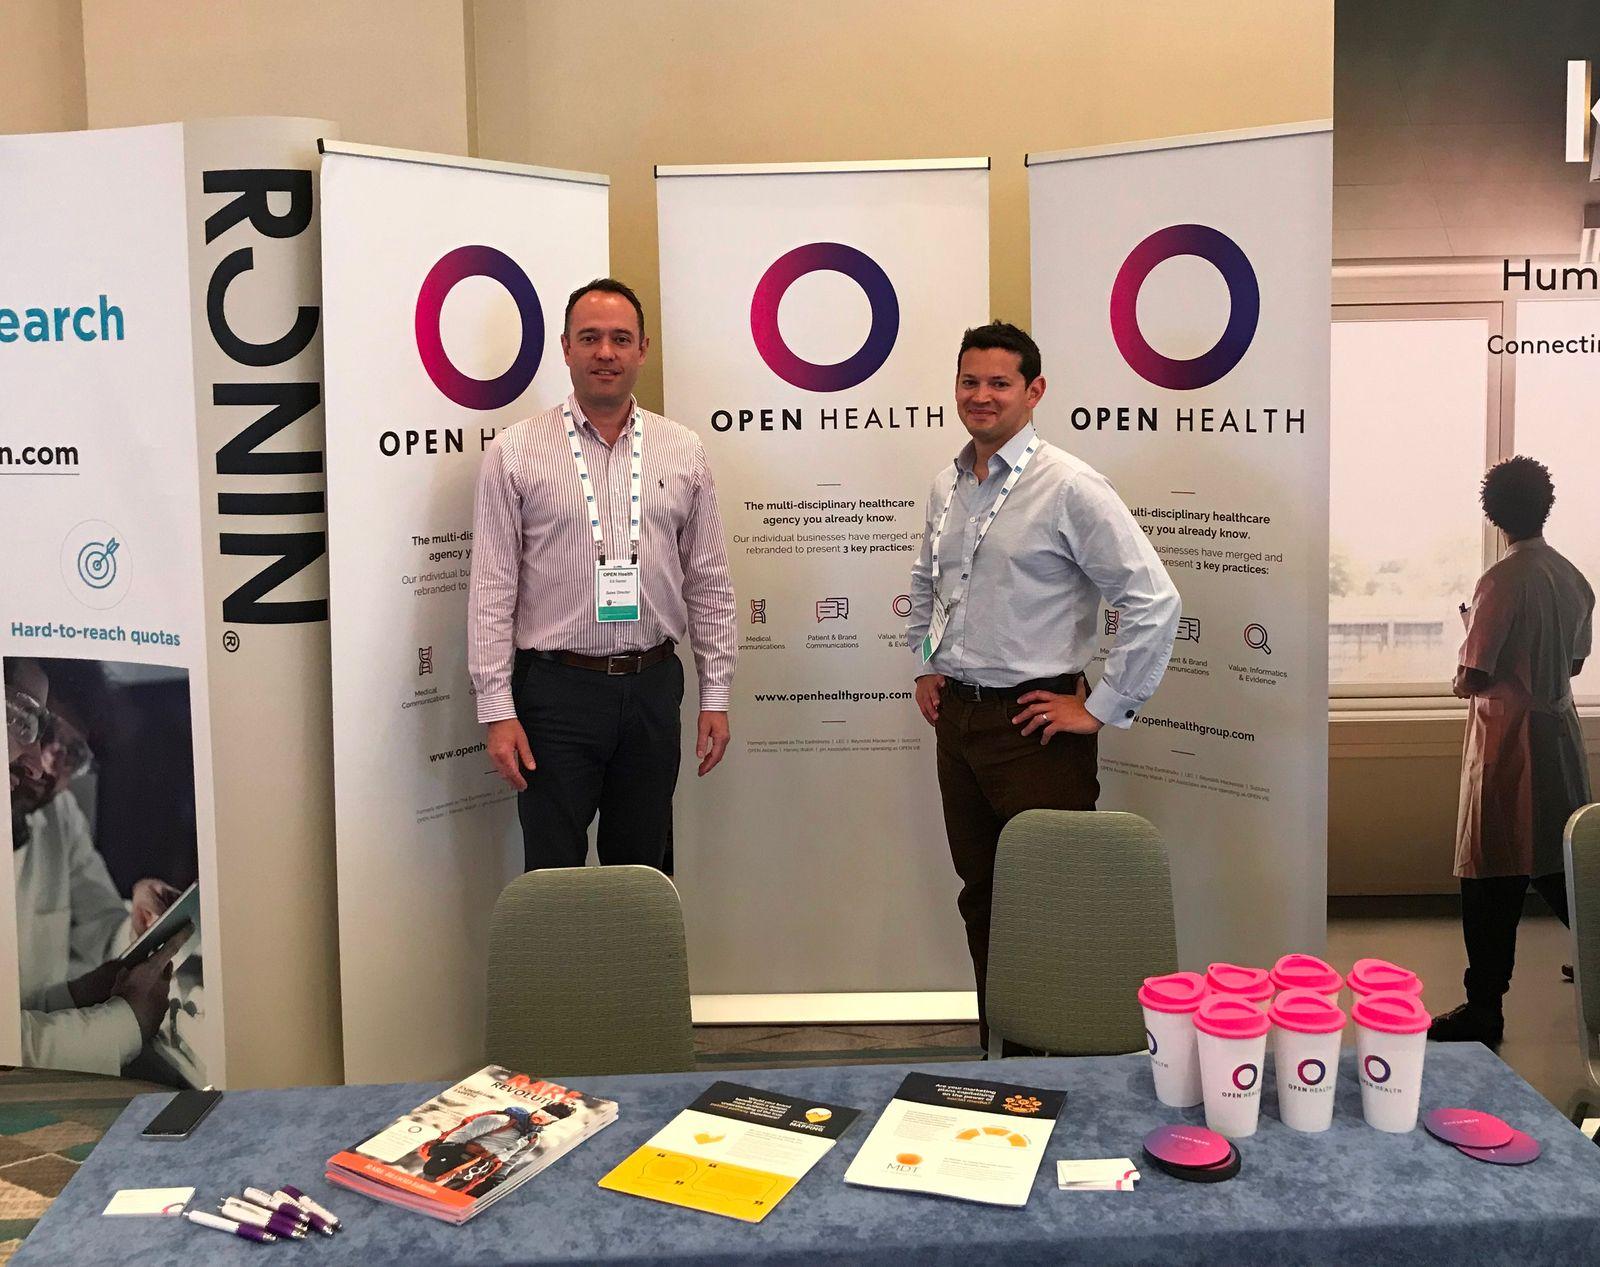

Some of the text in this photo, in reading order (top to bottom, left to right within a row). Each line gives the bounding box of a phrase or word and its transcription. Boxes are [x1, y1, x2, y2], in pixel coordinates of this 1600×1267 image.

[1503, 259, 1598, 291] Hum
[0, 294, 125, 343] earch
[1487, 333, 1600, 354] Connecti
[711, 405, 944, 432] OPEN HEALTH
[1071, 406, 1305, 434] OPEN HEALTH
[379, 428, 464, 456] OPEN
[744, 499, 915, 512] The multi-disciplinary healthcare
[762, 513, 897, 526] agency you already know.
[1130, 507, 1271, 525] ulti-disciplinary healthcare
[733, 534, 749, 543] Our
[752, 533, 795, 543] individual
[796, 532, 846, 543] businesses
[848, 532, 871, 542] have
[872, 531, 908, 543] merged
[1156, 525, 1176, 536] you
[1178, 525, 1217, 539] already
[1219, 528, 1251, 540] know.
[412, 535, 430, 546] The
[428, 548, 464, 562] agency
[746, 542, 915, 555] rebranded to present 3 key practices:
[1201, 547, 1223, 559] have
[1225, 550, 1262, 563] merged
[1264, 553, 1283, 563] and
[1196, 561, 1201, 570] 3
[1203, 560, 1220, 573] key
[1222, 562, 1270, 576] practices:
[401, 575, 417, 585] Our
[420, 569, 458, 582] individual
[414, 582, 468, 597] rebranded to
[11, 621, 181, 647] Hard-to-reach quotas
[745, 634, 772, 642] Medical
[807, 633, 830, 641] Patient
[837, 633, 858, 641] Brand
[805, 641, 860, 650] Communications
[1188, 658, 1208, 667] Brand
[1249, 666, 1288, 678] Informatics
[1245, 675, 1277, 686] Evidence
[414, 687, 438, 697] Medical
[754, 689, 912, 703] www.openhealthgroup.com
[401, 694, 450, 710] Communications
[1288, 1083, 1307, 1093] OPEN
[1375, 1084, 1402, 1093] HEALTH
